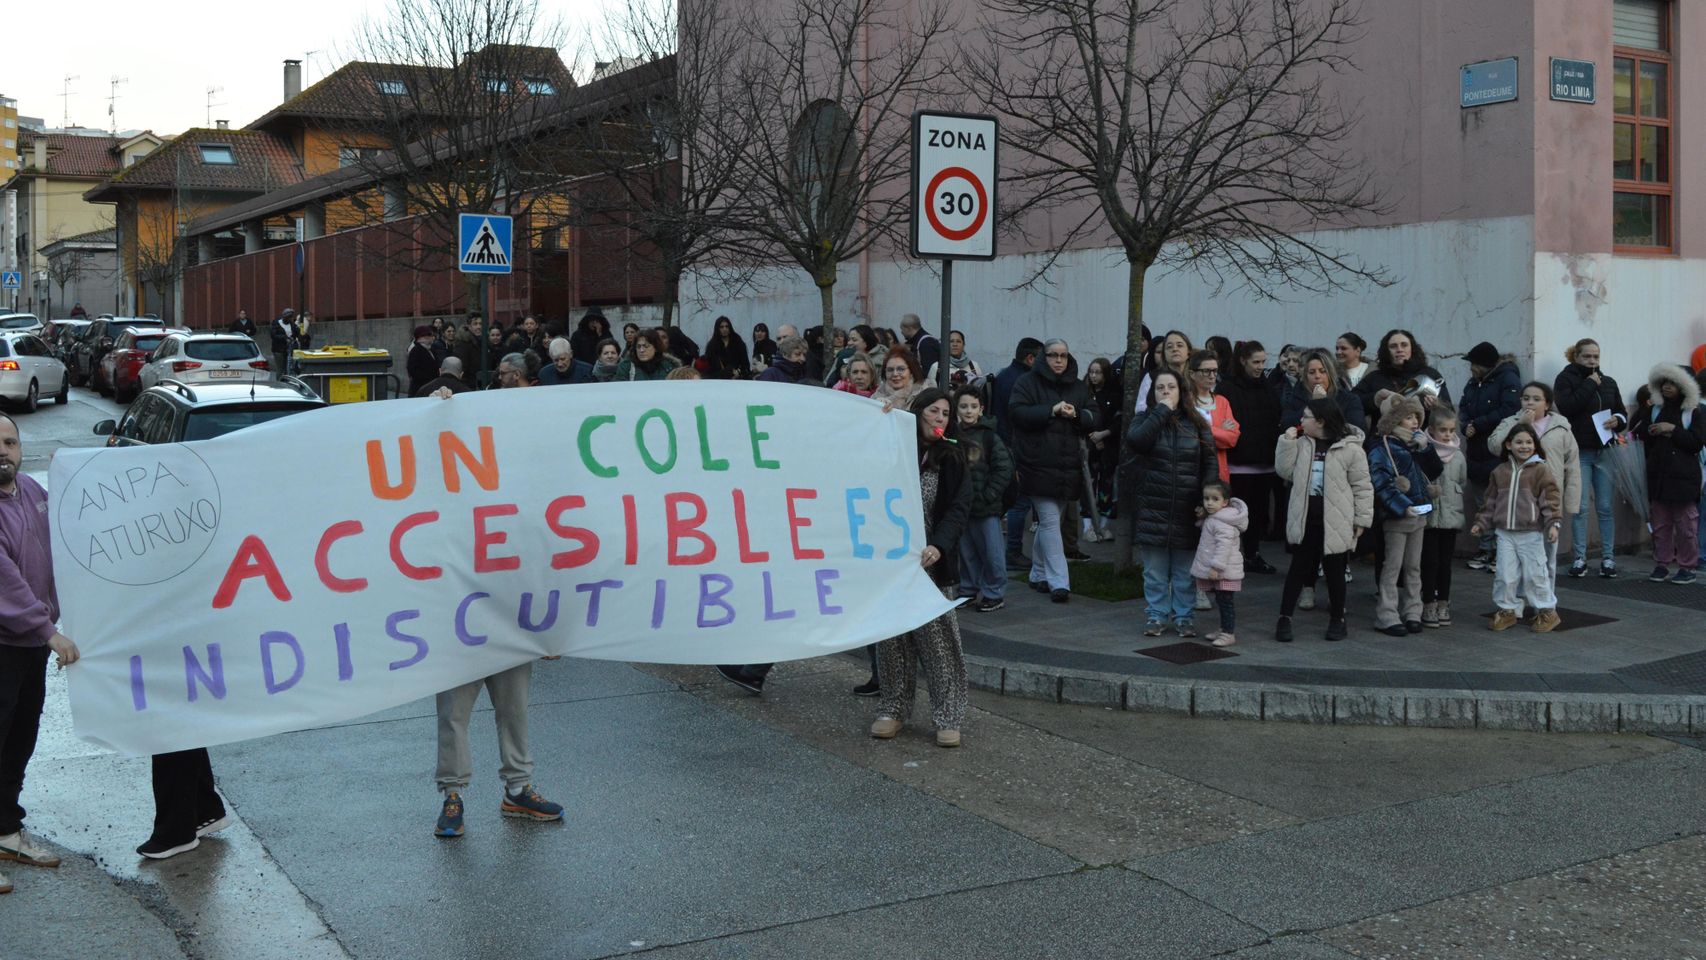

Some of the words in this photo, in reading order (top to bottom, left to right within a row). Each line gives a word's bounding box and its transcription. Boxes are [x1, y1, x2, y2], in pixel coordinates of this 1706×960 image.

[1464, 86, 1512, 102] PONTEDEUME
[1556, 83, 1569, 96] RIO
[1571, 85, 1590, 99] LIMIA
[928, 129, 987, 150] ZONA
[940, 192, 974, 215] 30
[366, 426, 499, 501] UN
[577, 404, 780, 478] COLE
[89, 498, 217, 569] ATURUXO
[212, 488, 825, 609] ACCESIBLE
[845, 487, 910, 560] ES
[129, 569, 843, 711] INDISCUTIBLE
